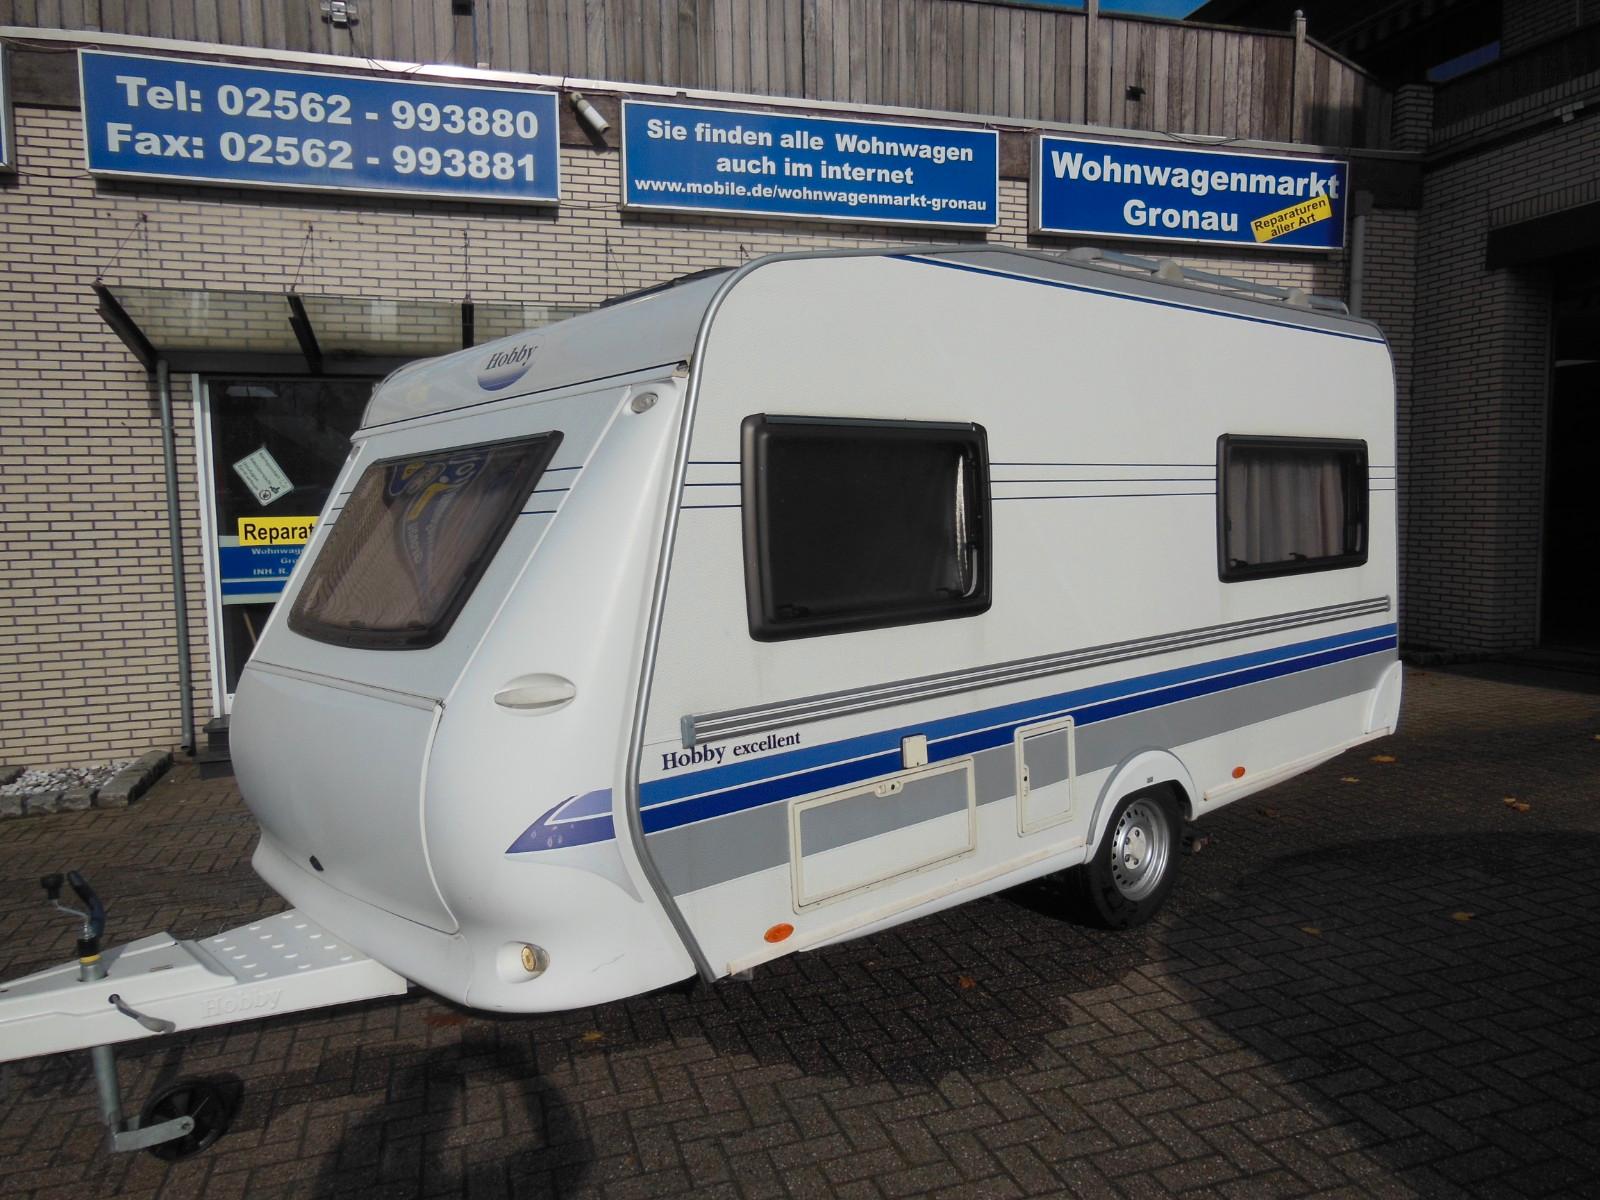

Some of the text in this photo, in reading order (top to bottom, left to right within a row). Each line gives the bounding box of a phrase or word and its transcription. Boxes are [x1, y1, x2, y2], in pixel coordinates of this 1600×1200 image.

[116, 75, 202, 113] Tel:
[217, 84, 352, 126] 02562
[391, 100, 538, 140] 993880
[106, 122, 204, 160] Fax:
[219, 131, 353, 171] 02562
[393, 145, 536, 182] 993881
[647, 118, 974, 164] Sie finden alle Wohnwagen
[716, 155, 914, 185] auch im internet
[1051, 150, 1340, 199] Wohnwagenmarkt
[634, 178, 987, 210] www.mobile.de/wohnwagenmarkt-gronau
[1123, 198, 1238, 232] Gronau
[1254, 199, 1326, 231] Reparaturen
[1270, 212, 1317, 237] aller Art
[485, 344, 538, 370] Hobby
[662, 731, 801, 771] Hobby excellent
